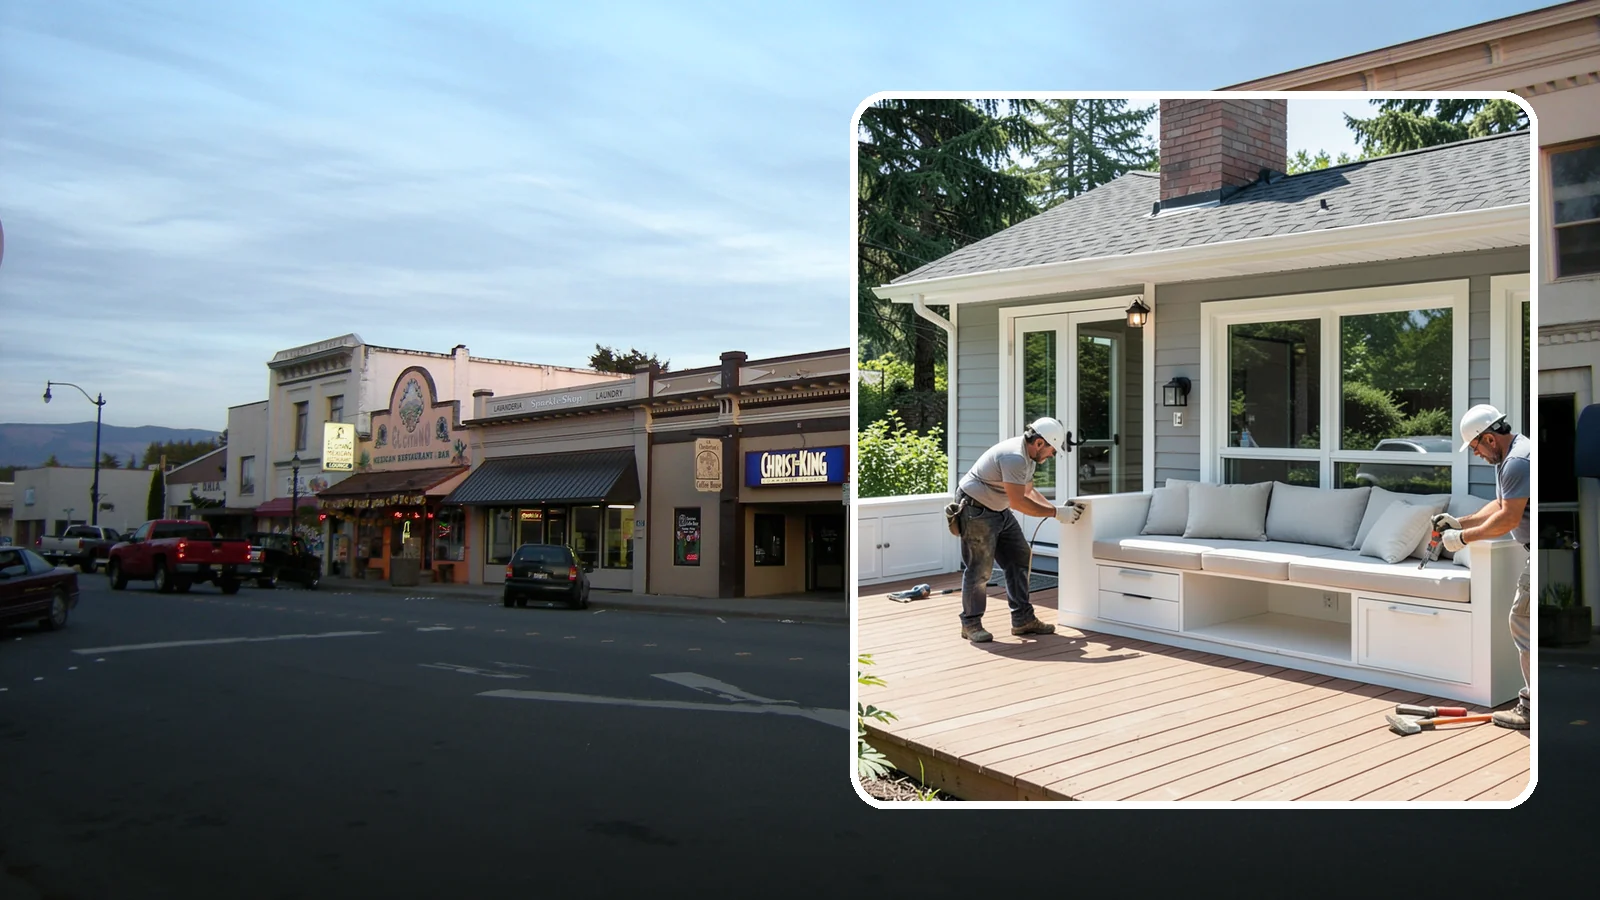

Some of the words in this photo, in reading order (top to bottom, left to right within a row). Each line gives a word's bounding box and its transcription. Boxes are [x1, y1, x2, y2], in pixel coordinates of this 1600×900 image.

[595, 388, 624, 400] LAUNDRY
[493, 402, 523, 413] LAVANDERIA
[530, 398, 561, 409] Sparkle
[561, 393, 582, 404] Shop
[373, 455, 396, 464] MEXICAN
[397, 452, 433, 462] RESTAURANT
[438, 450, 450, 459] BAR
[761, 452, 797, 478] CHRIST
[799, 450, 827, 476] KING
[696, 481, 709, 489] Coffee
